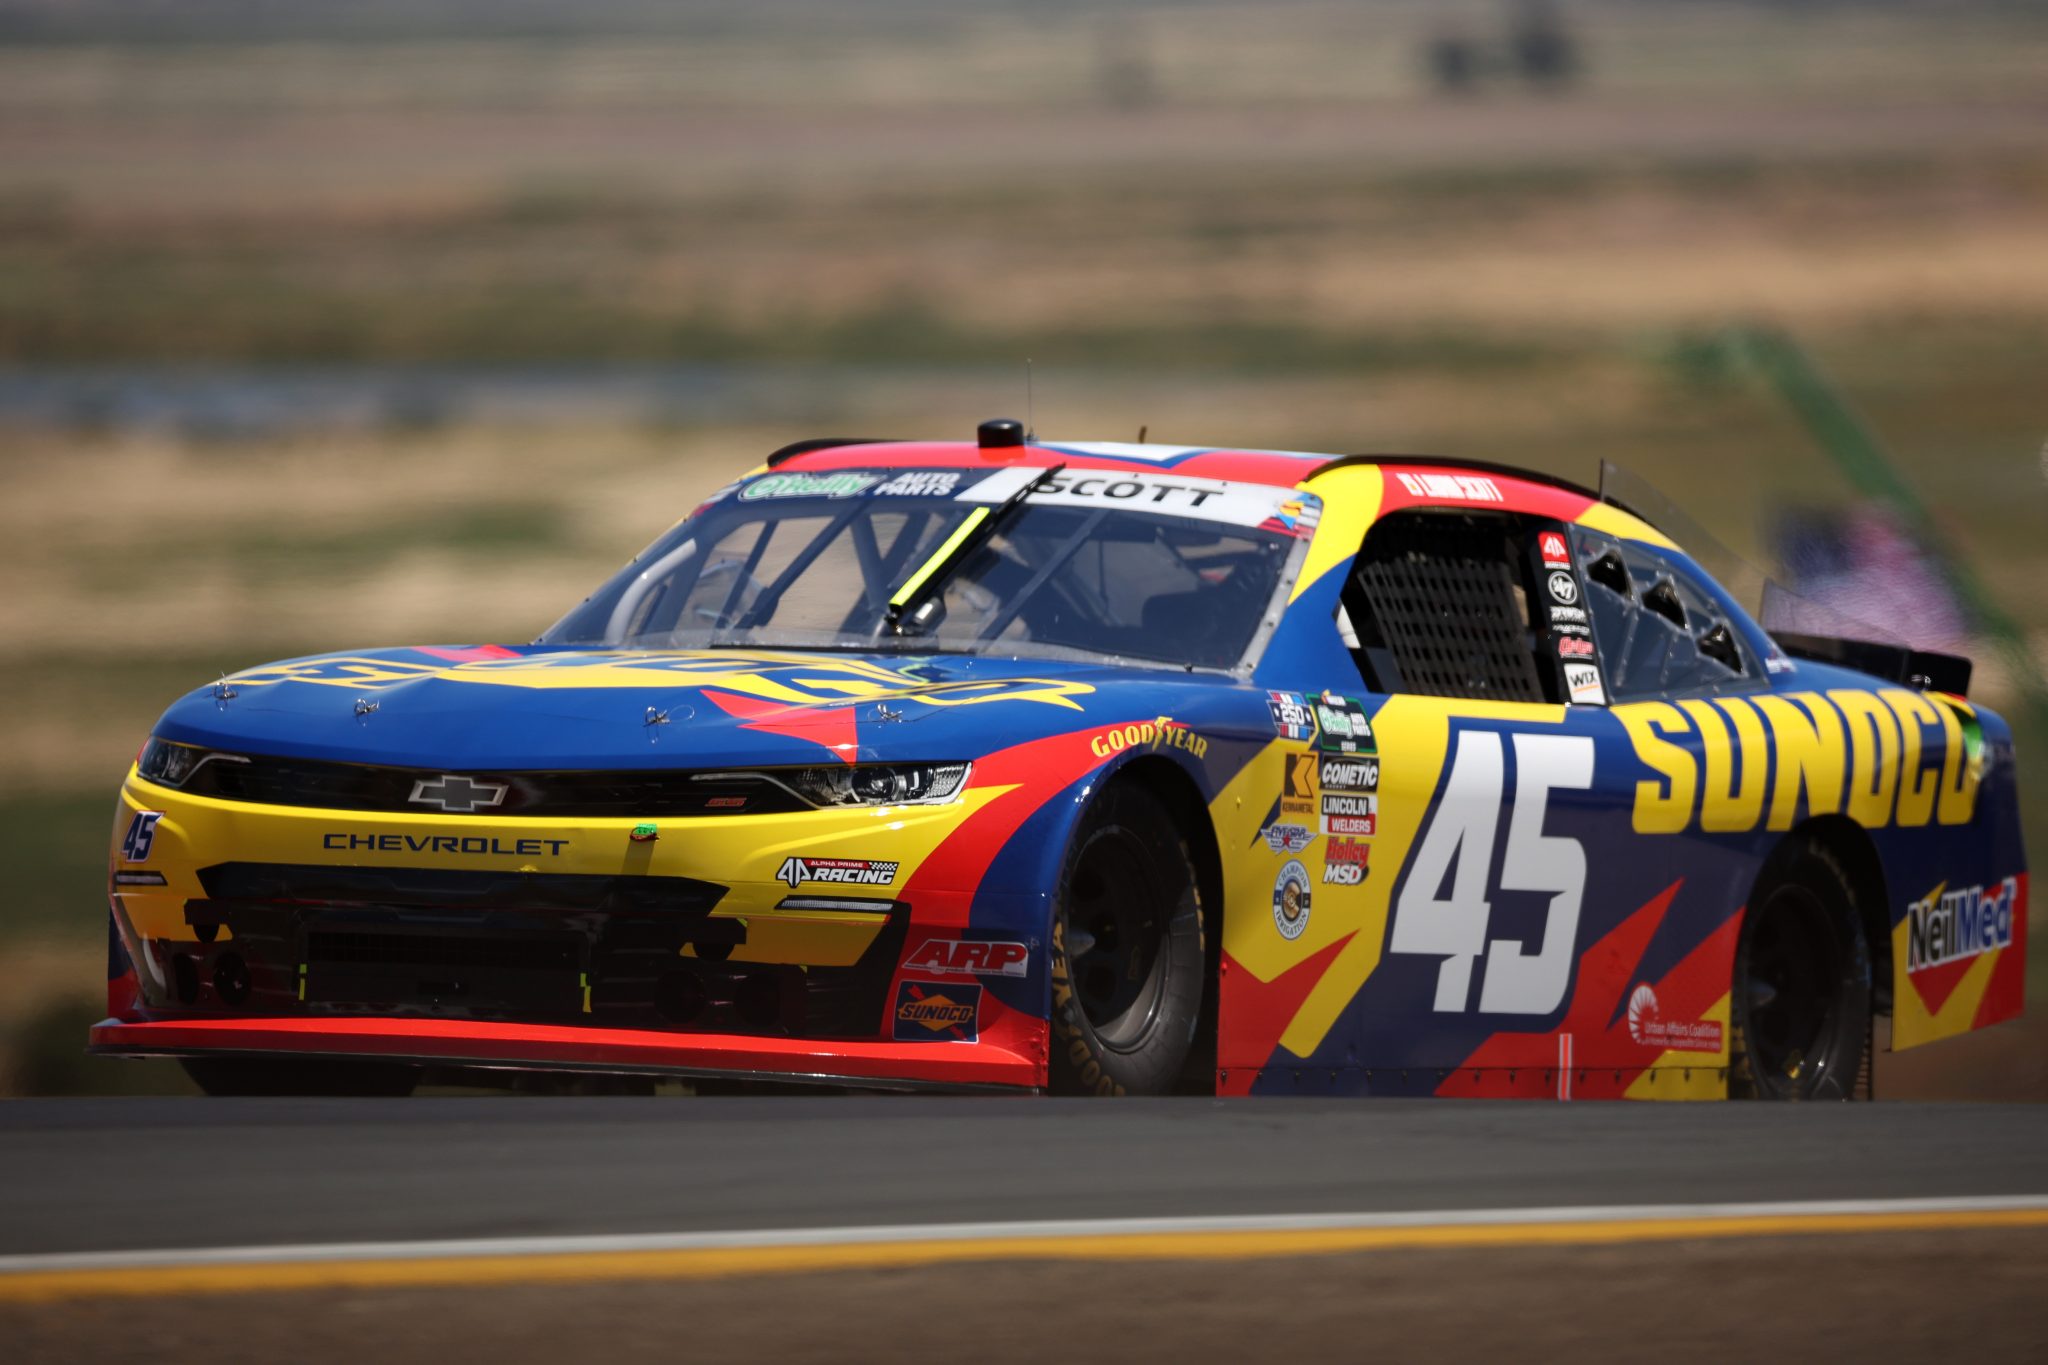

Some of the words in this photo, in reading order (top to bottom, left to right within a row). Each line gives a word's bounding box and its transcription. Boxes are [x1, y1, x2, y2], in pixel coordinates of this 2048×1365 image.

[874, 483, 955, 496] PARTS
[893, 473, 960, 484] AUTO
[1034, 477, 1224, 507] SCOTT
[1570, 670, 1598, 687] WIX
[1280, 704, 1305, 724] 250
[1091, 716, 1208, 760] GOODYEAR
[1608, 689, 1980, 834] SUNOCO
[1321, 761, 1379, 786] COMETIC
[1323, 796, 1367, 816] LINCOLN
[121, 810, 165, 863] 45
[1331, 818, 1372, 833] WELDERS
[323, 833, 570, 856] CHEVROLET
[1326, 836, 1370, 869] Holley
[812, 868, 896, 885] RACING
[1278, 864, 1308, 887] CHAMPION
[1323, 863, 1364, 885] MSD
[1390, 729, 1595, 1015] 45
[1275, 910, 1308, 937] IRRIGATION
[1907, 877, 2017, 974] NeilMed
[906, 940, 1028, 970] ARP
[899, 1003, 973, 1022] SUNOCO
[1644, 1021, 1665, 1034] Urban
[1665, 1021, 1688, 1036] Affairs
[1689, 1023, 1721, 1038] Coalition
